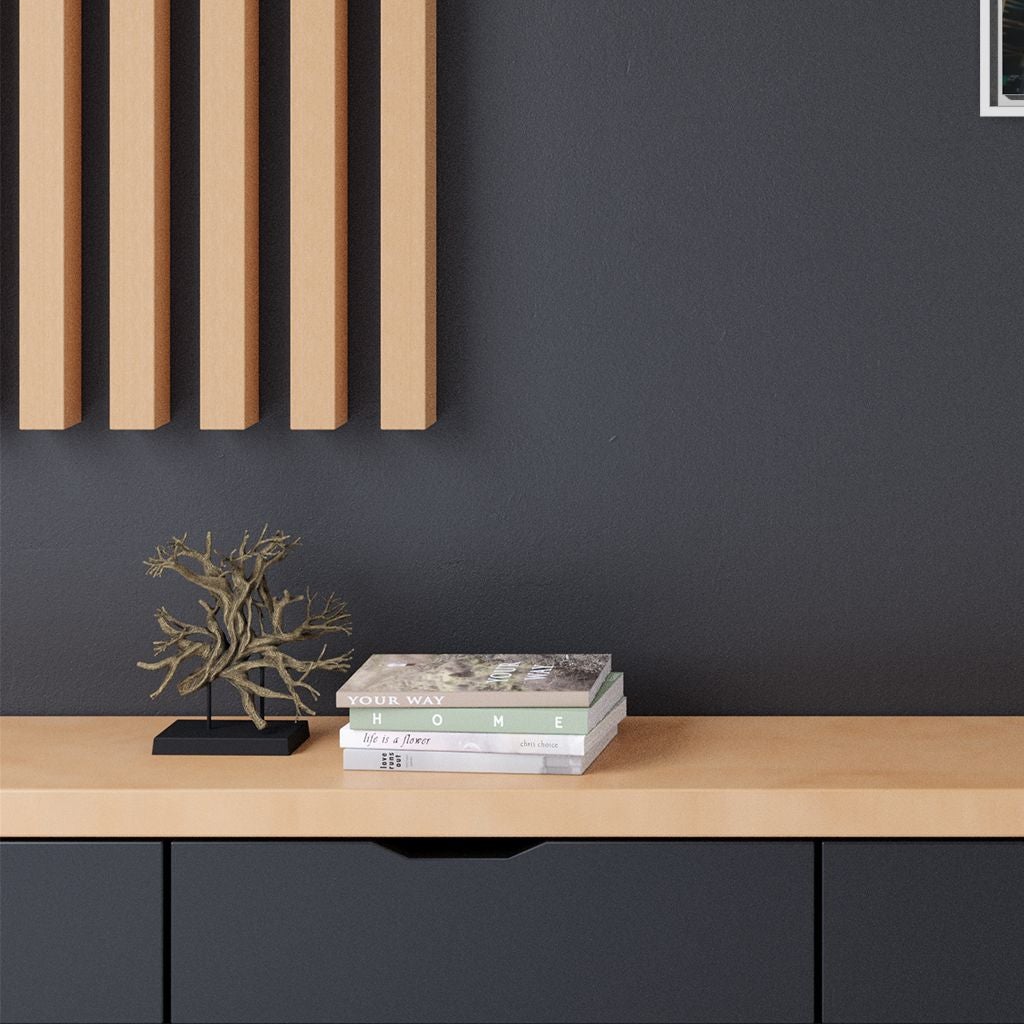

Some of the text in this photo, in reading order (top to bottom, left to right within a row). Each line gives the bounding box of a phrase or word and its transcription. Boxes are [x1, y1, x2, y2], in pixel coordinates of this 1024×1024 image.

[348, 696, 445, 705] YOUR WAY
[372, 712, 563, 729] HOME
[363, 733, 379, 746] life
[382, 734, 389, 744] is
[400, 734, 431, 748] flower
[520, 739, 559, 748] chris choice
